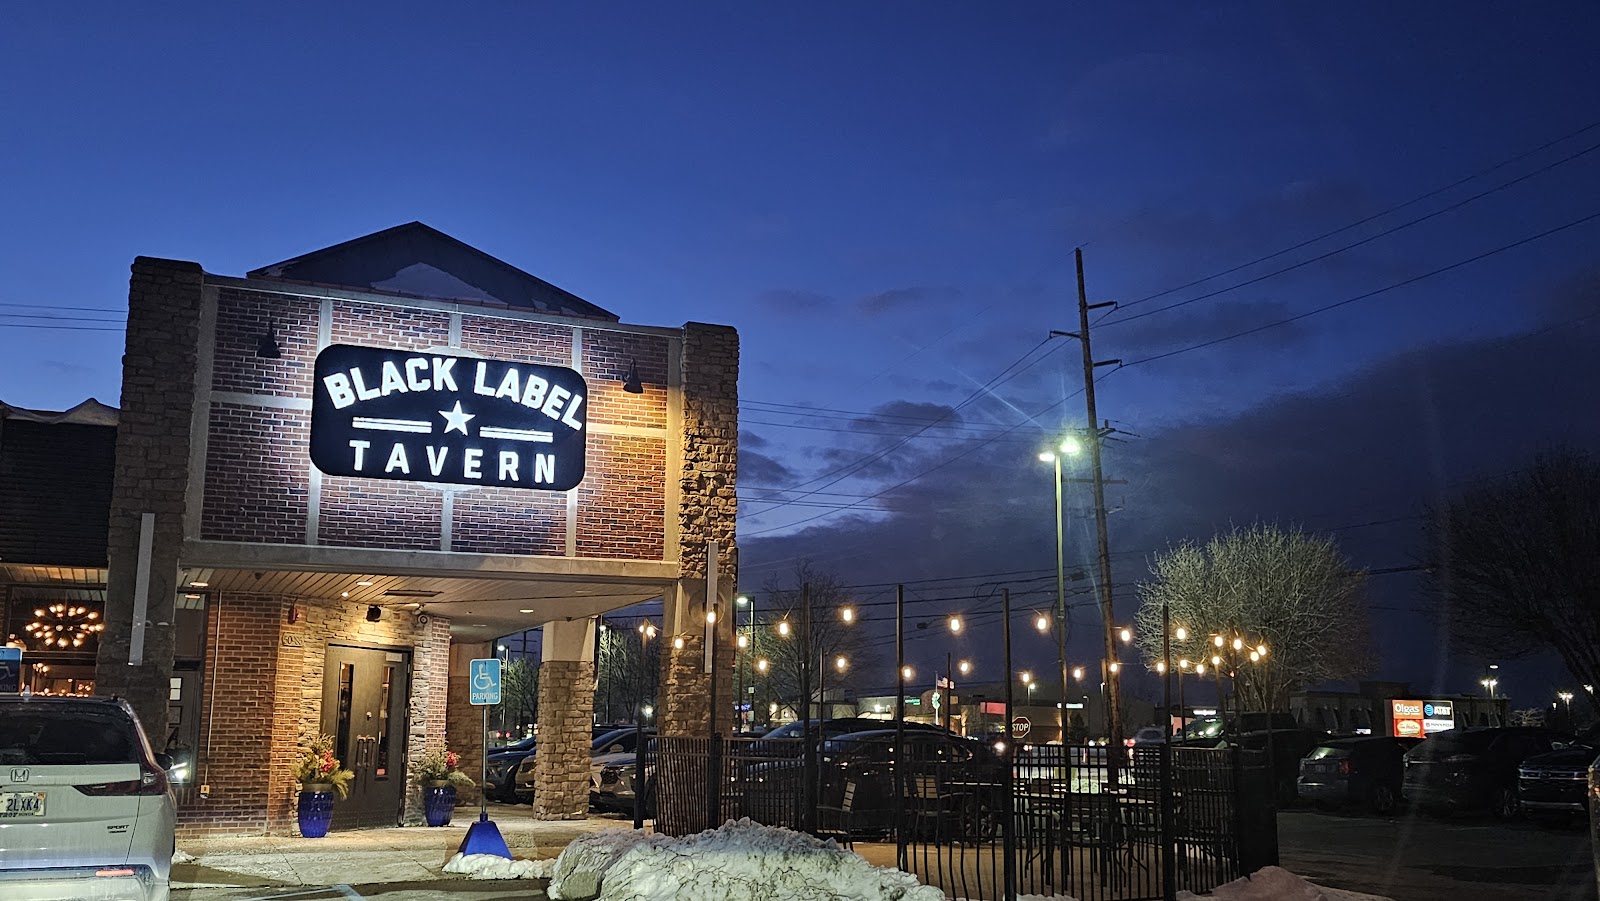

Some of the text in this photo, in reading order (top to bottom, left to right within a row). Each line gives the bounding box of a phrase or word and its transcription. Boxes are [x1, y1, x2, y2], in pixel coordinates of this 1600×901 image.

[323, 357, 584, 431] BLACK LABEL
[349, 440, 555, 485] TAVERN
[472, 692, 498, 700] PARKING
[1394, 703, 1420, 715] Olgas
[1433, 706, 1451, 715] AT&T
[1012, 723, 1029, 731] STOP
